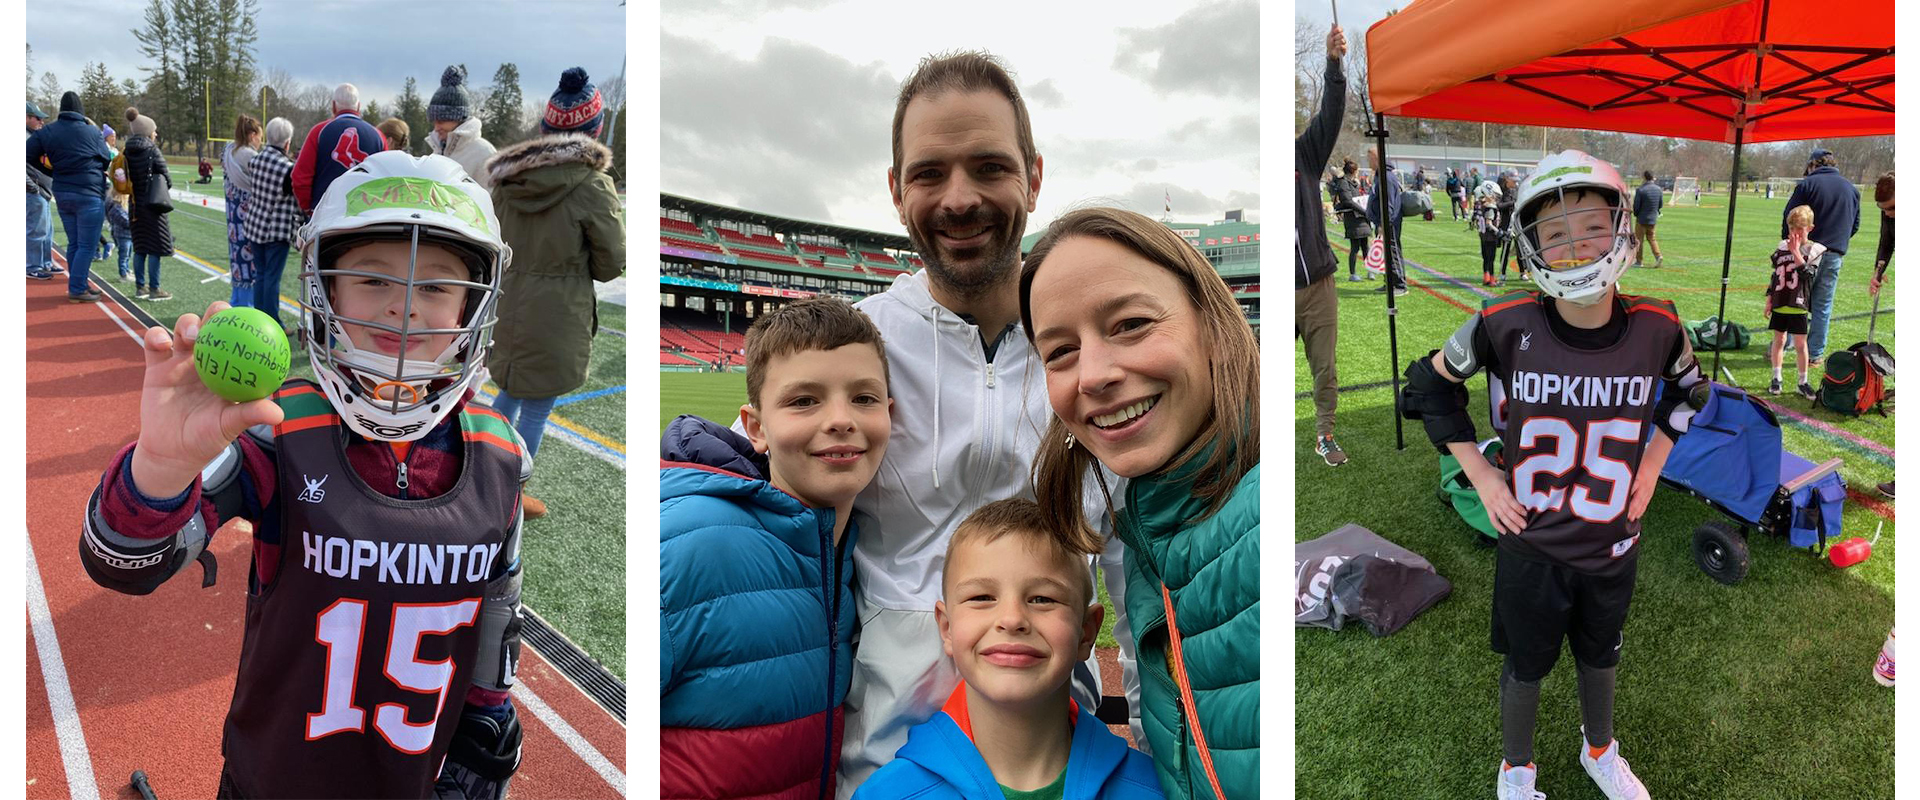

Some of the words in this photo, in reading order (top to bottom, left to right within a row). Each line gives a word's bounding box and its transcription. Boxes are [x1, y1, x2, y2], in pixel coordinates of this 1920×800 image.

[196, 349, 257, 388] 4/3/22
[1512, 416, 1643, 524] 25
[304, 597, 482, 755] 15
